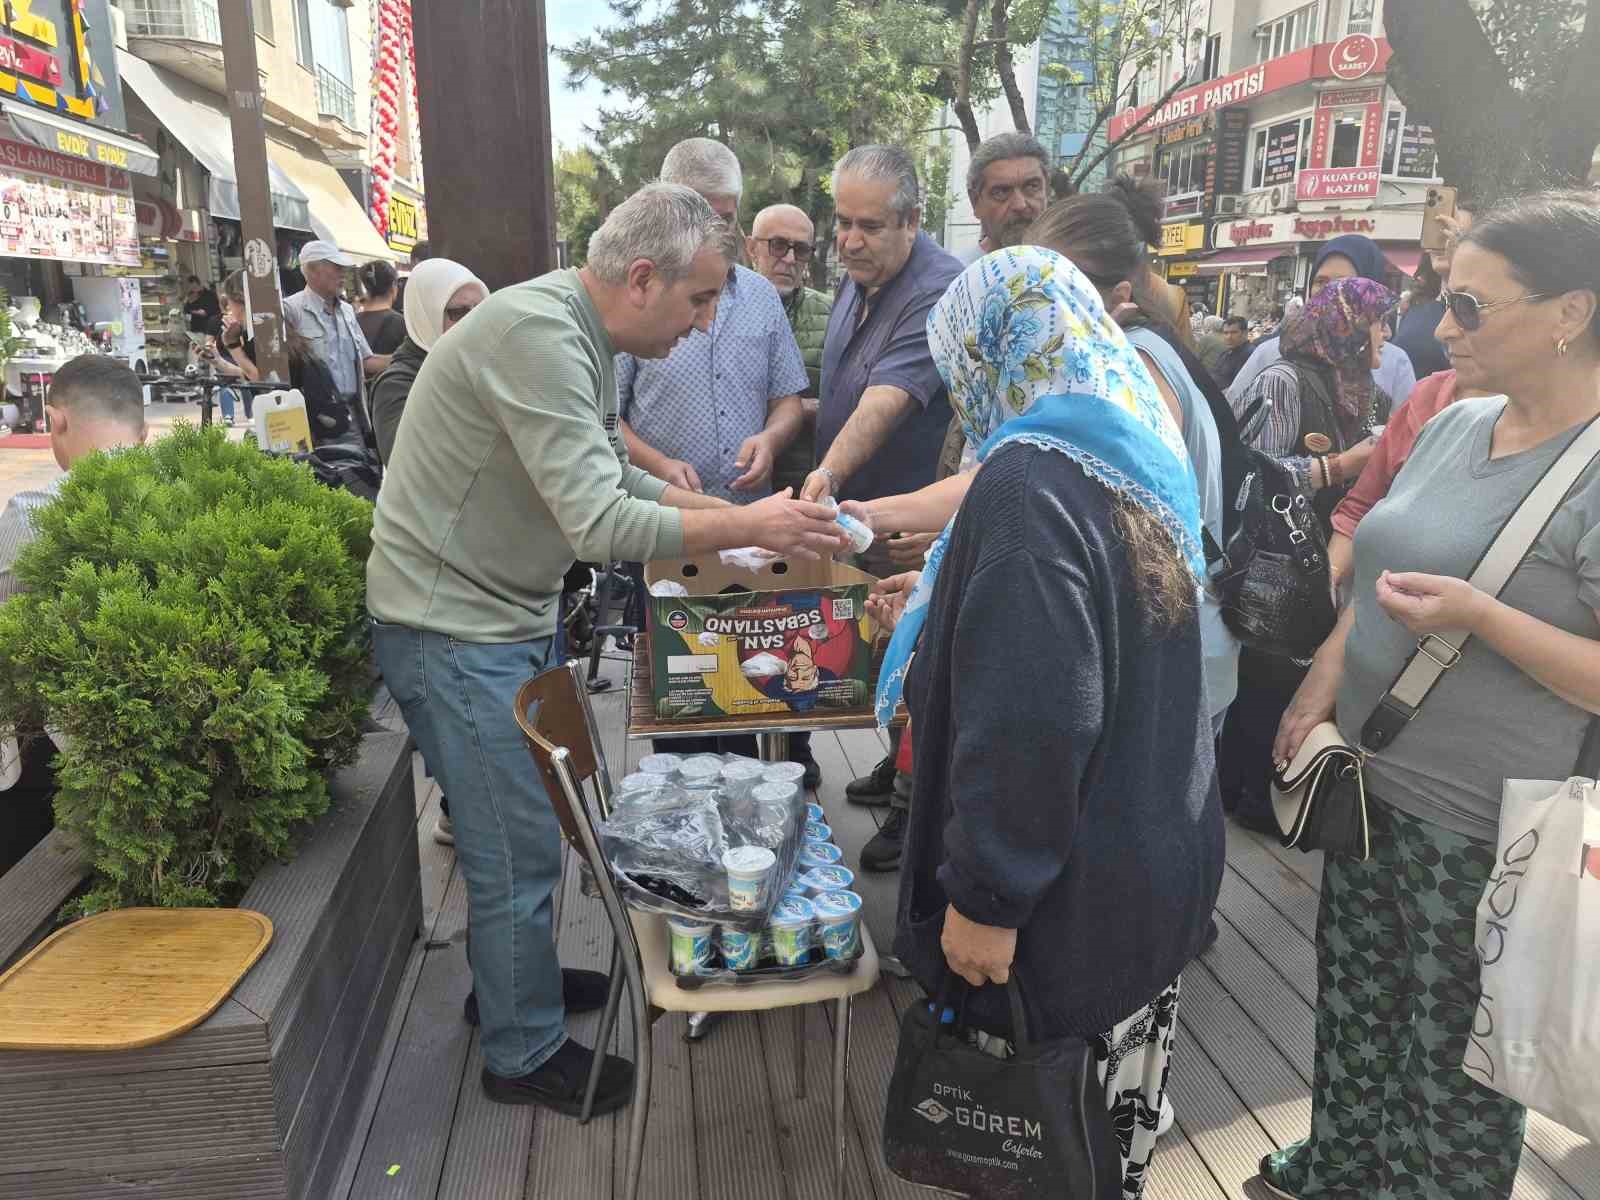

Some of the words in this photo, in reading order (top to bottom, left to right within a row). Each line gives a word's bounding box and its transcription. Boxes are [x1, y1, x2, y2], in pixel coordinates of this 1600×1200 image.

[1203, 65, 1265, 110] PARTİSİ
[1326, 183, 1369, 194] KAZIM
[705, 609, 821, 634] SEBASTIANO
[745, 634, 784, 649] SAN
[934, 1083, 973, 1102] OPTİK
[956, 1104, 1042, 1140] GÖREM
